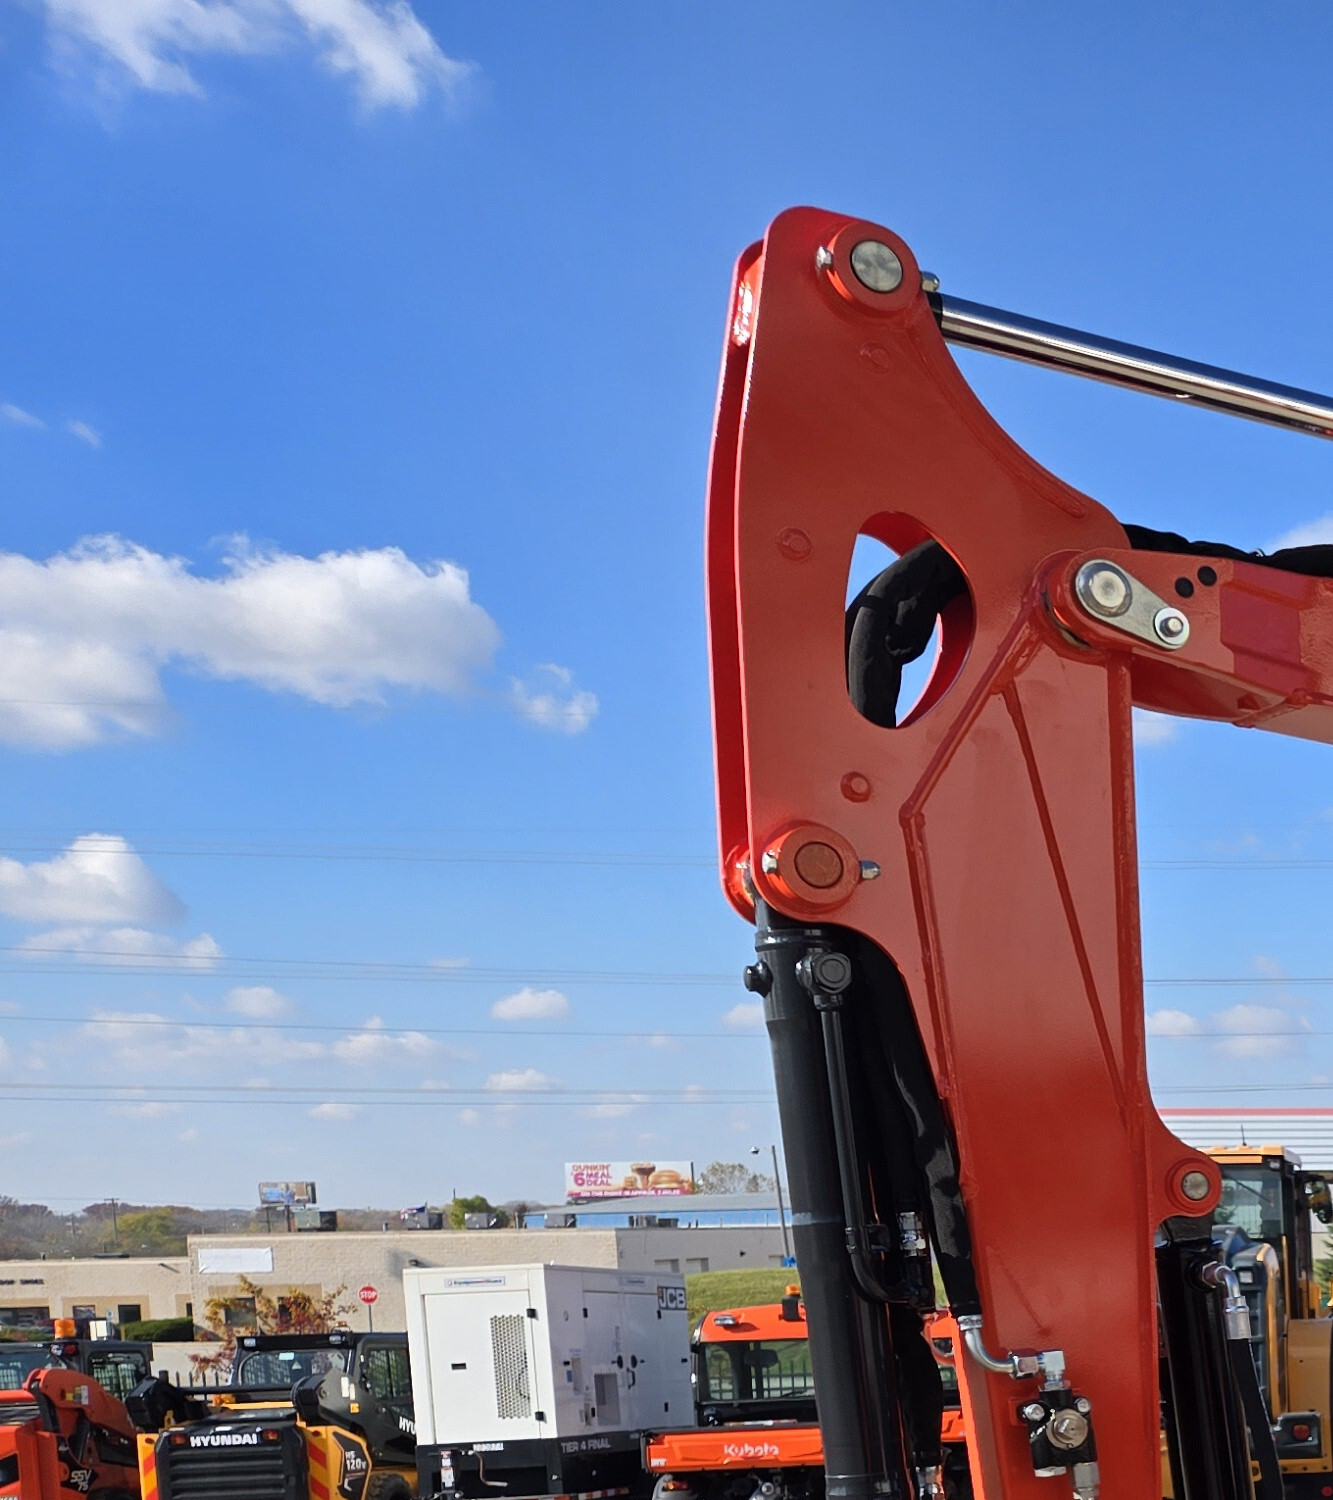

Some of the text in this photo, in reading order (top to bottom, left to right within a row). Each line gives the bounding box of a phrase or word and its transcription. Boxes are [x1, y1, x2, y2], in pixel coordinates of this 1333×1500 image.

[586, 1179, 611, 1187] DEAL
[360, 1291, 377, 1299] STOP
[658, 1287, 686, 1309] JCB
[189, 1434, 258, 1448] HYUNDAI
[561, 1438, 611, 1454] TIER 4 FINAL
[723, 1442, 779, 1457] Kubota
[70, 1468, 92, 1483] SSV
[78, 1481, 89, 1492] 75
